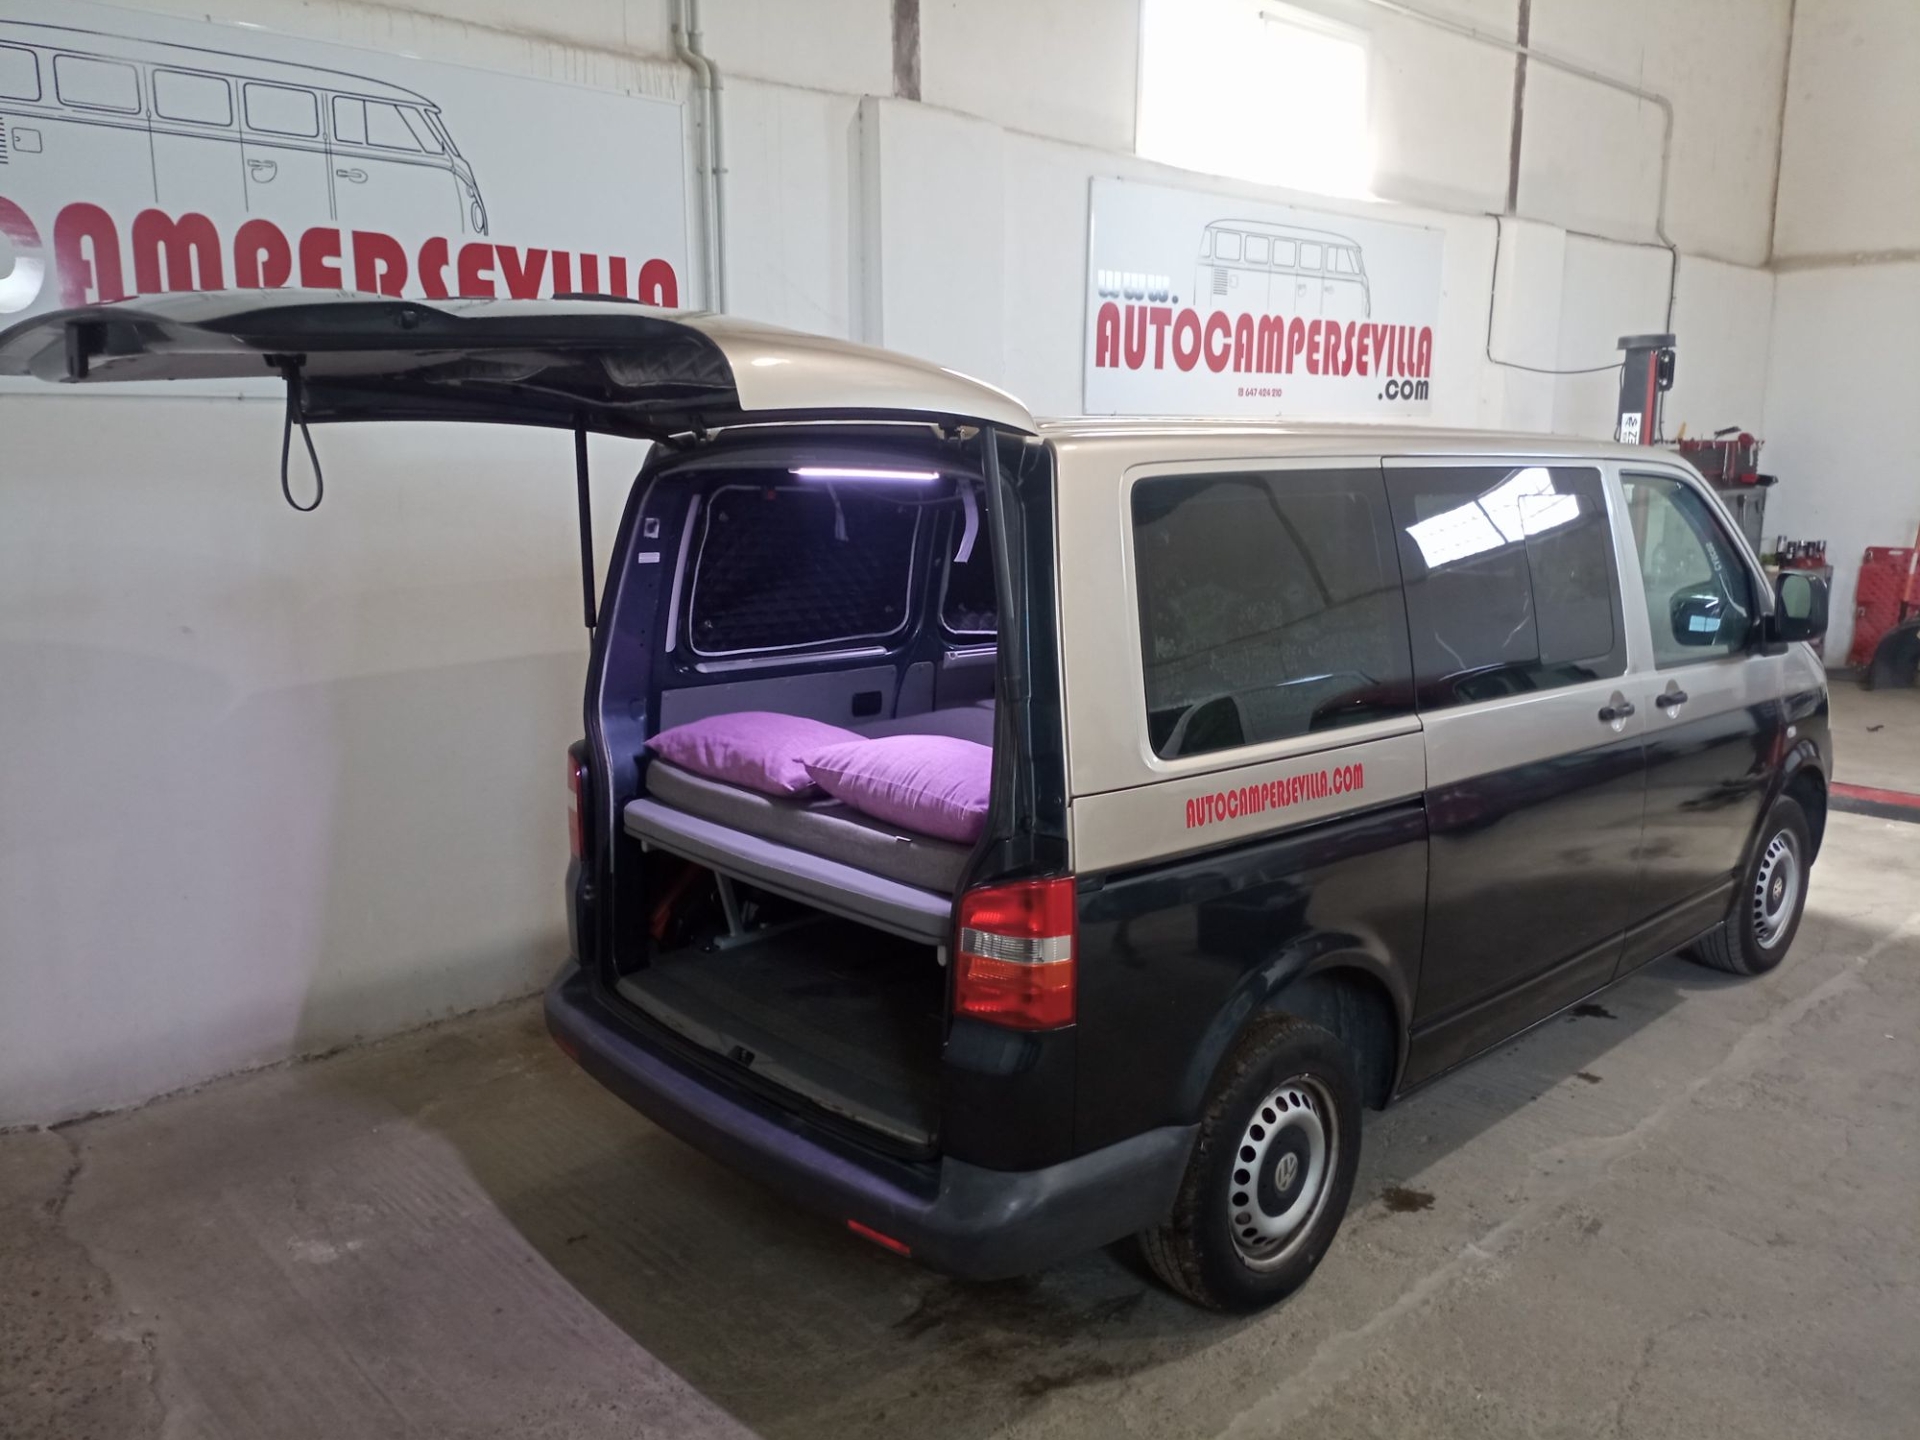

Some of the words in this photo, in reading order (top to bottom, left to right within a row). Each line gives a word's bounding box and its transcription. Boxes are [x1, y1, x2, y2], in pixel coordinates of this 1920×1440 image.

[1095, 302, 1433, 379] AUTOCAMPERSEVILLA
[1245, 387, 1258, 397] 647
[1186, 762, 1364, 828] AUTOCAMPERSEVILLA.COM
